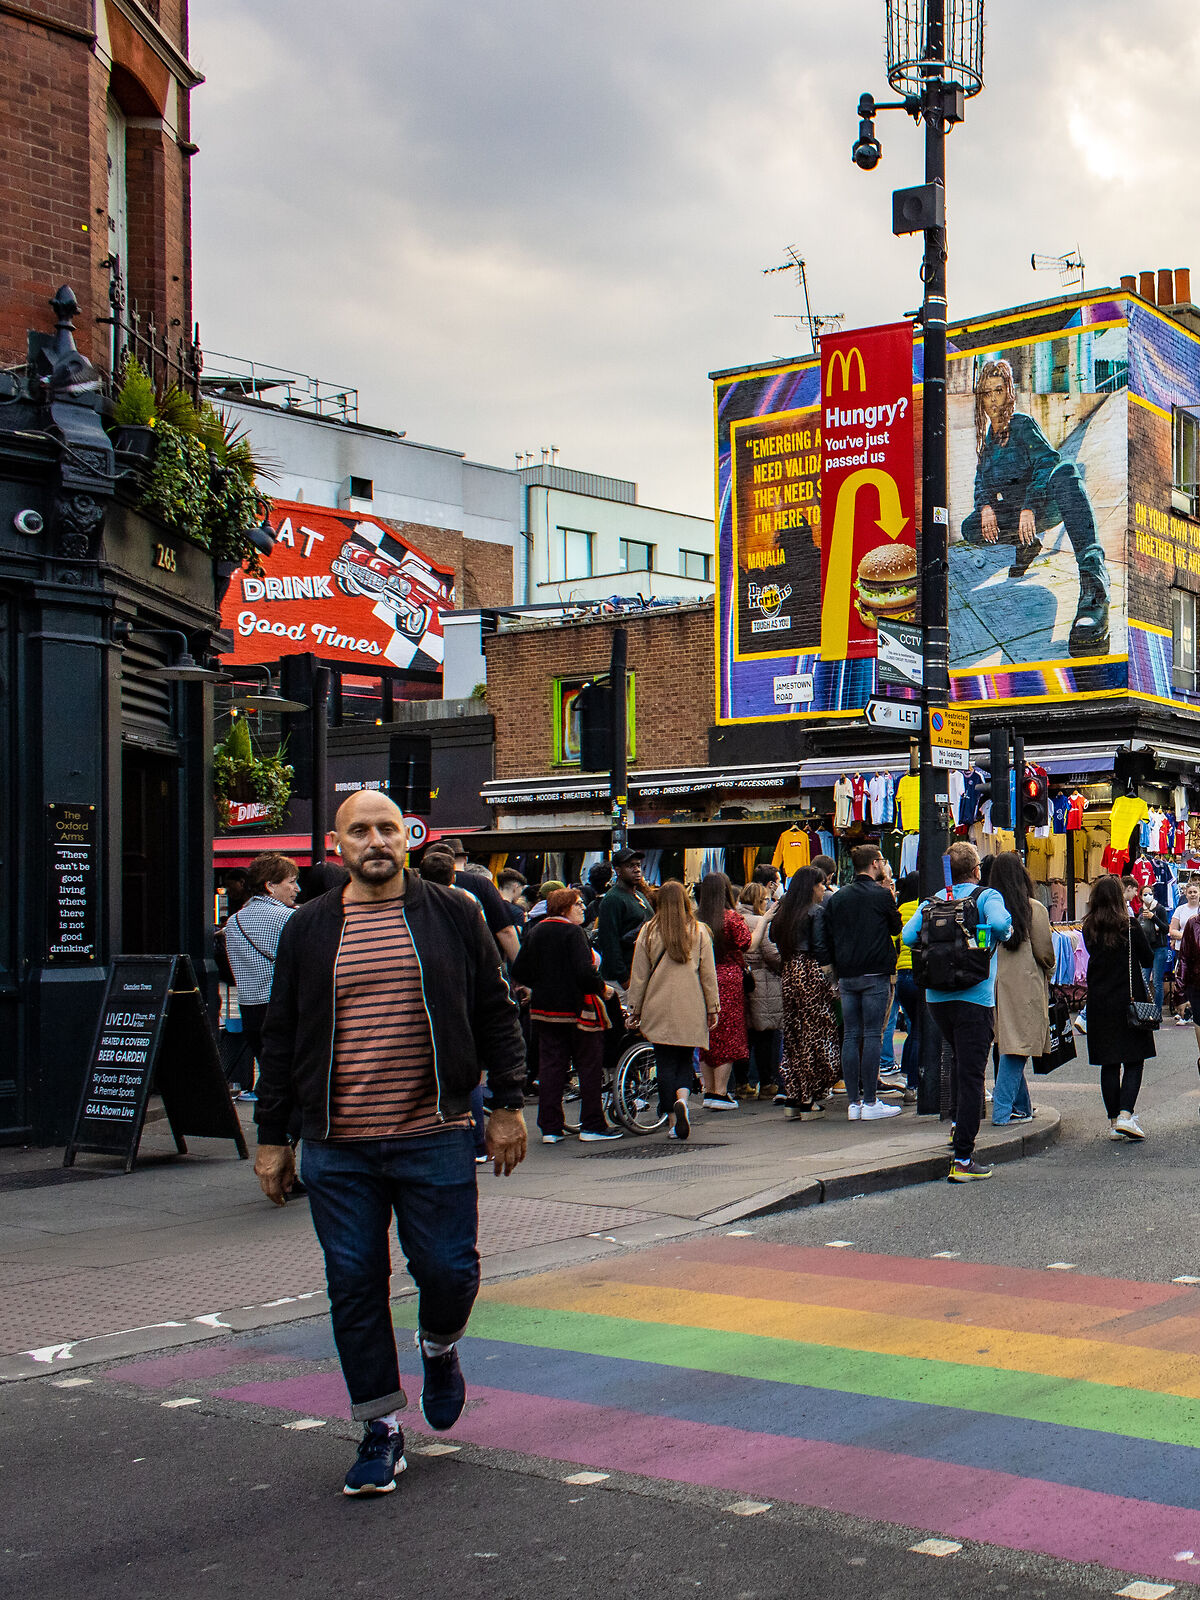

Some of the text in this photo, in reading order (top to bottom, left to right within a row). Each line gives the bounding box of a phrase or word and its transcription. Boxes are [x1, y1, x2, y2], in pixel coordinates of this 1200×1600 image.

[825, 397, 908, 429] Hungry?
[814, 428, 822, 448] A
[824, 431, 890, 452] You’ve just
[824, 451, 886, 473] passed us
[753, 454, 822, 485] NEED VALID
[753, 478, 822, 509] THEY NEED S
[774, 507, 804, 530] HERE
[1135, 501, 1147, 527] ON
[1148, 507, 1169, 536] YOUR
[1170, 516, 1188, 543] OWN
[276, 516, 325, 558] AT
[1135, 529, 1174, 565] TOGETHER
[1174, 545, 1187, 568] WE
[156, 544, 177, 573] 265
[747, 548, 786, 569] MAHALIA
[241, 575, 335, 603] DRINK
[749, 584, 793, 608] Martens
[753, 618, 789, 631] TOUGH AS YOU
[237, 611, 383, 656] Good Times
[899, 633, 922, 647] CCTV
[776, 681, 812, 691] JAMESTOWN
[776, 693, 793, 701] ROAD
[898, 709, 919, 724] LET
[944, 712, 968, 721] Restricted
[947, 720, 966, 729] Parking
[950, 727, 962, 736] Zone
[937, 736, 963, 746] At any time
[938, 750, 962, 760] No loading
[944, 759, 952, 767] any
[952, 758, 963, 766] time
[639, 788, 660, 796] CROPS
[662, 786, 690, 794] DRESSES
[737, 778, 785, 788] ACCESSORIES
[486, 790, 599, 804] VINTAGE CLOTHING HOODIES SWEATERS T
[64, 810, 81, 820] The
[56, 821, 89, 831] Oxford
[60, 832, 85, 841] Arms
[79, 862, 90, 871] be
[61, 874, 84, 883] good
[1141, 875, 1150, 886] 7
[59, 886, 86, 896] living
[58, 898, 87, 906] where
[60, 909, 85, 917] there
[59, 921, 85, 929] is not
[61, 933, 83, 942] good
[123, 983, 153, 991] Camden Town
[105, 1012, 135, 1027] LIVE DJ
[101, 1036, 150, 1047] HEATED & COVERED
[98, 1049, 147, 1063] BEER GARDEN
[92, 1073, 142, 1085] Sky Sports BT Sports
[93, 1085, 135, 1098] & Premier Sports
[86, 1104, 135, 1117] GAA Shown Live
